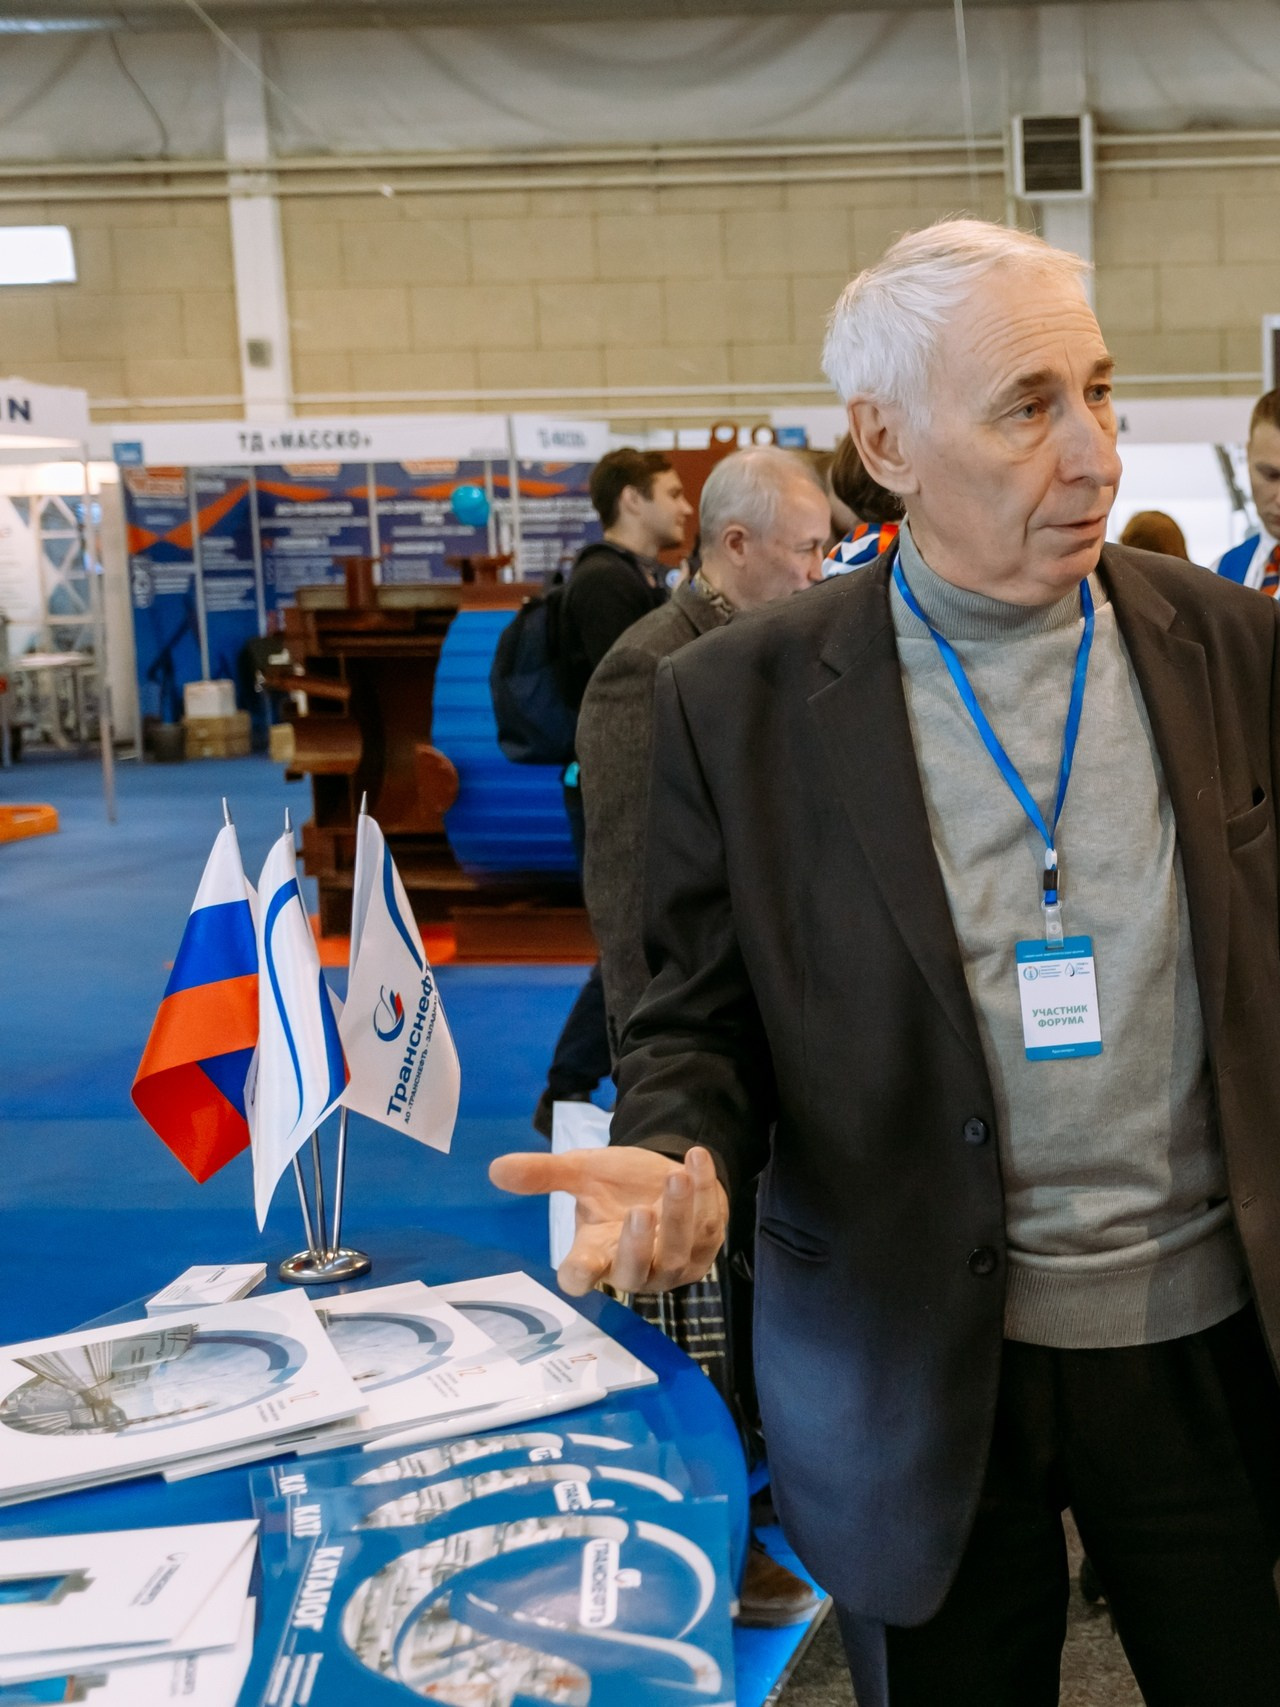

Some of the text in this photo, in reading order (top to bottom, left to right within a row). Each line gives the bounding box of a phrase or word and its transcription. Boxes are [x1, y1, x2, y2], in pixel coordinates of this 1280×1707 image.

[238, 431, 264, 451] ТД
[1032, 1005, 1088, 1017] УЧАСТНИК
[1038, 1016, 1084, 1027] ФОРУМА
[292, 1545, 345, 1632] КАТАЛОГ
